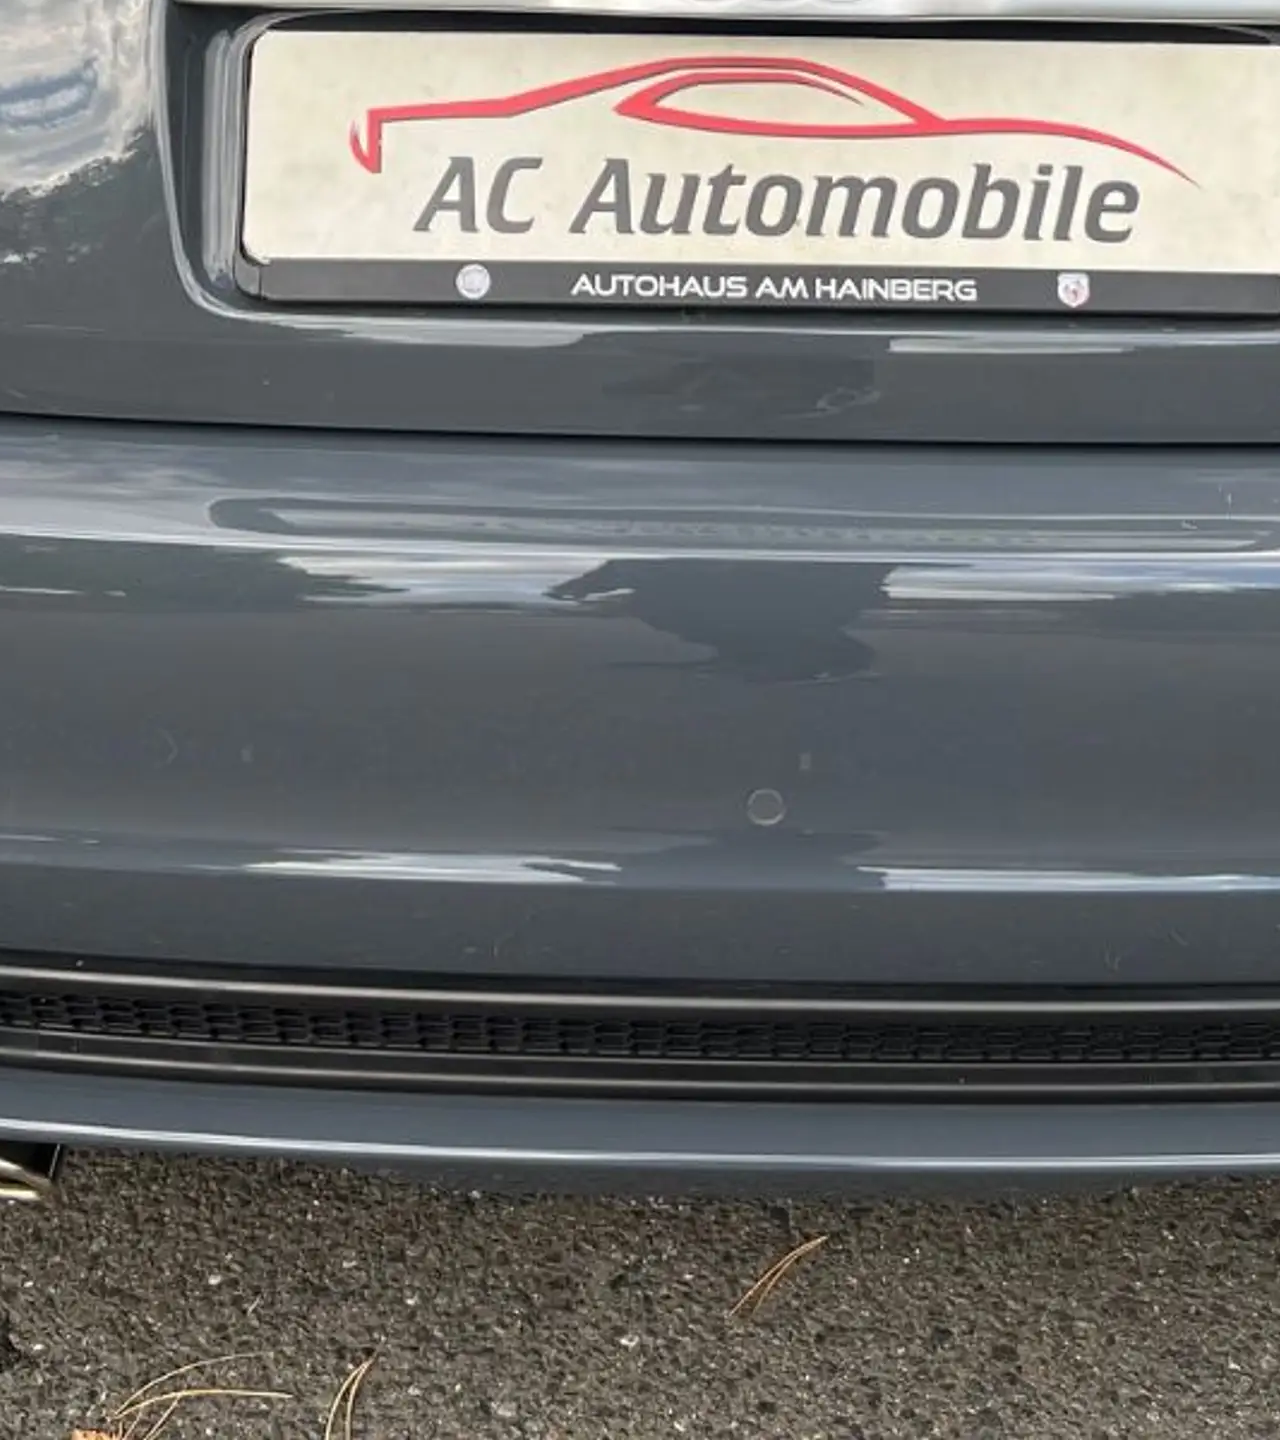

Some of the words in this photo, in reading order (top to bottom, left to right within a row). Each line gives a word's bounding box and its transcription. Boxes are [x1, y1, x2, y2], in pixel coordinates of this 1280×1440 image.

[413, 156, 543, 234] AC
[568, 158, 1140, 243] Automobile
[571, 273, 747, 297] AUTOHAUS
[754, 276, 809, 300] AM
[815, 277, 977, 302] HAINBERG
